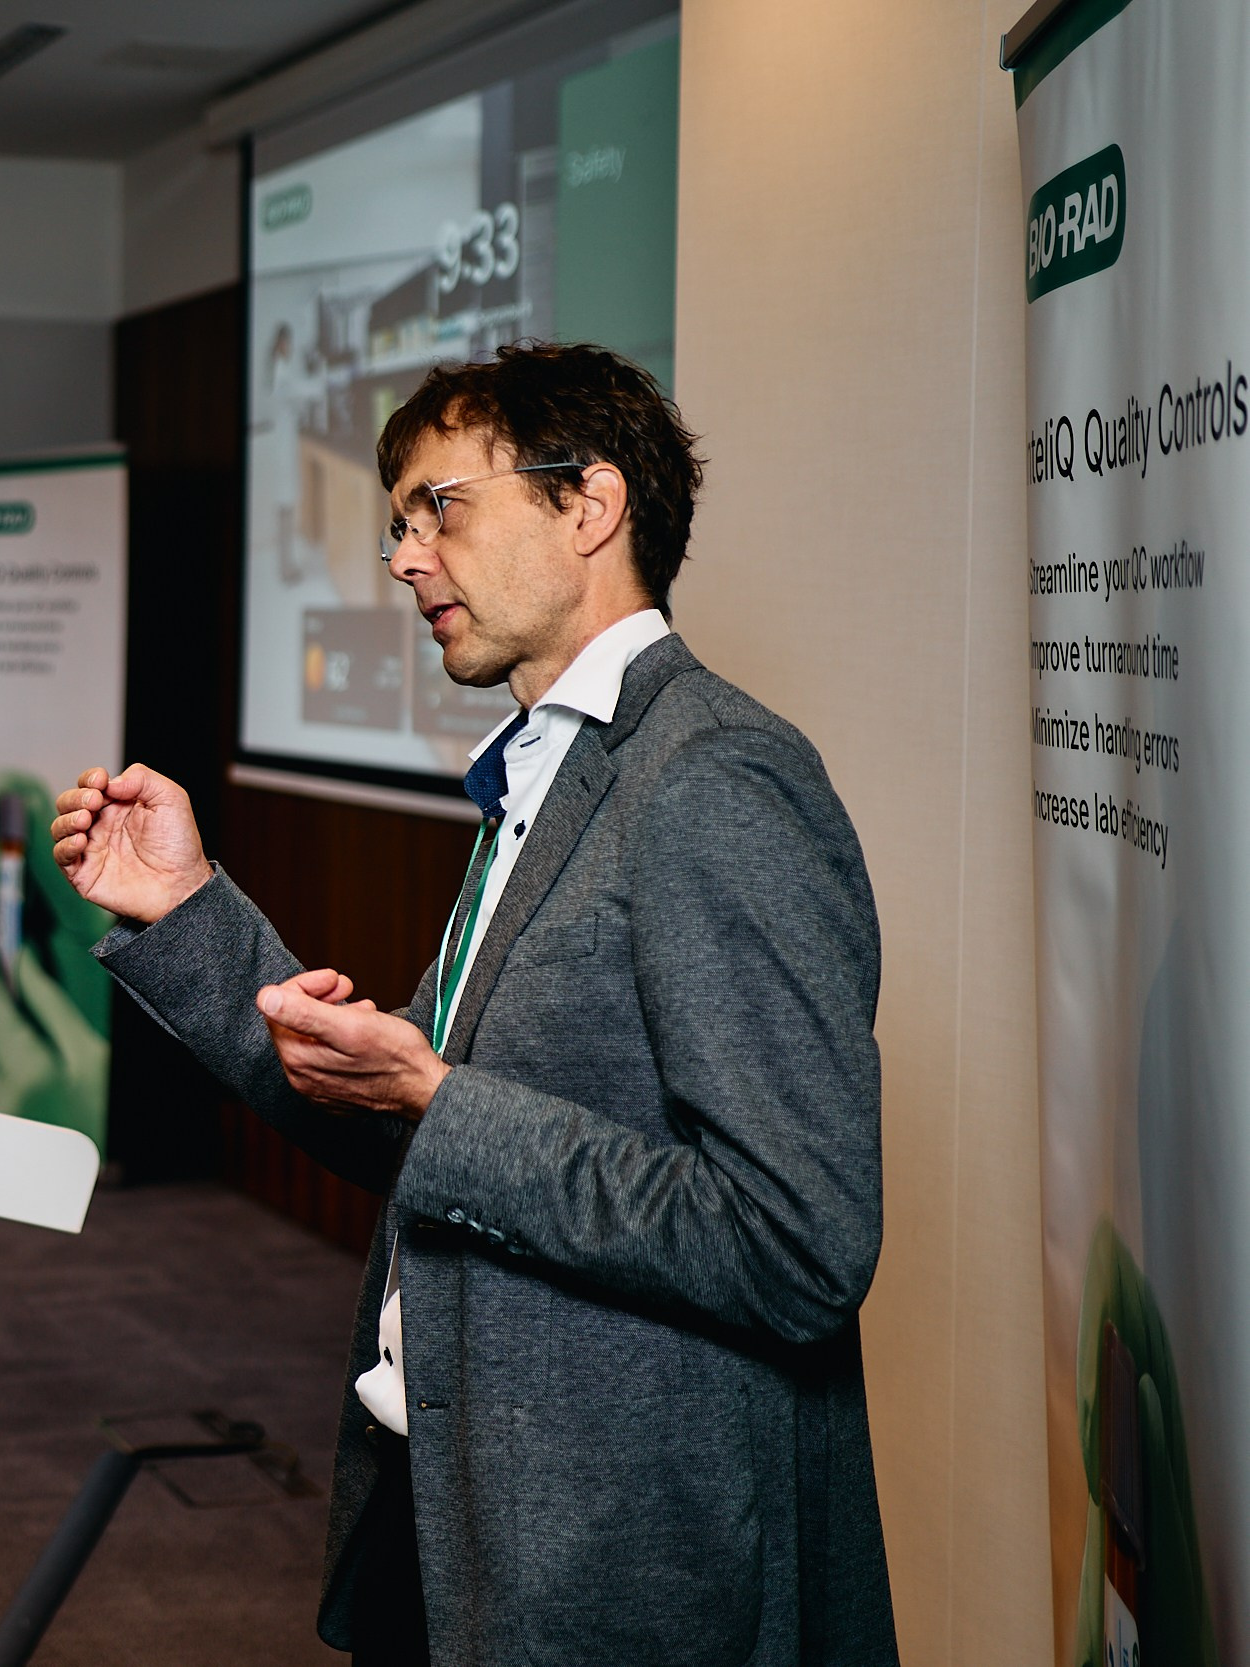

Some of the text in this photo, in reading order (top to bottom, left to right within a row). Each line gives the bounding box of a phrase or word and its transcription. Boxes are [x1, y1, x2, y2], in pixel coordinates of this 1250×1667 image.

[1027, 173, 1119, 281] BIO-RAD
[1084, 394, 1152, 479] Quality
[1158, 359, 1249, 456] Controls
[1029, 539, 1205, 603] Streamline your QC workflow
[1084, 634, 1149, 678] turnaround
[1152, 633, 1179, 681] time
[1143, 731, 1180, 773] errors
[1094, 792, 1119, 837] lab
